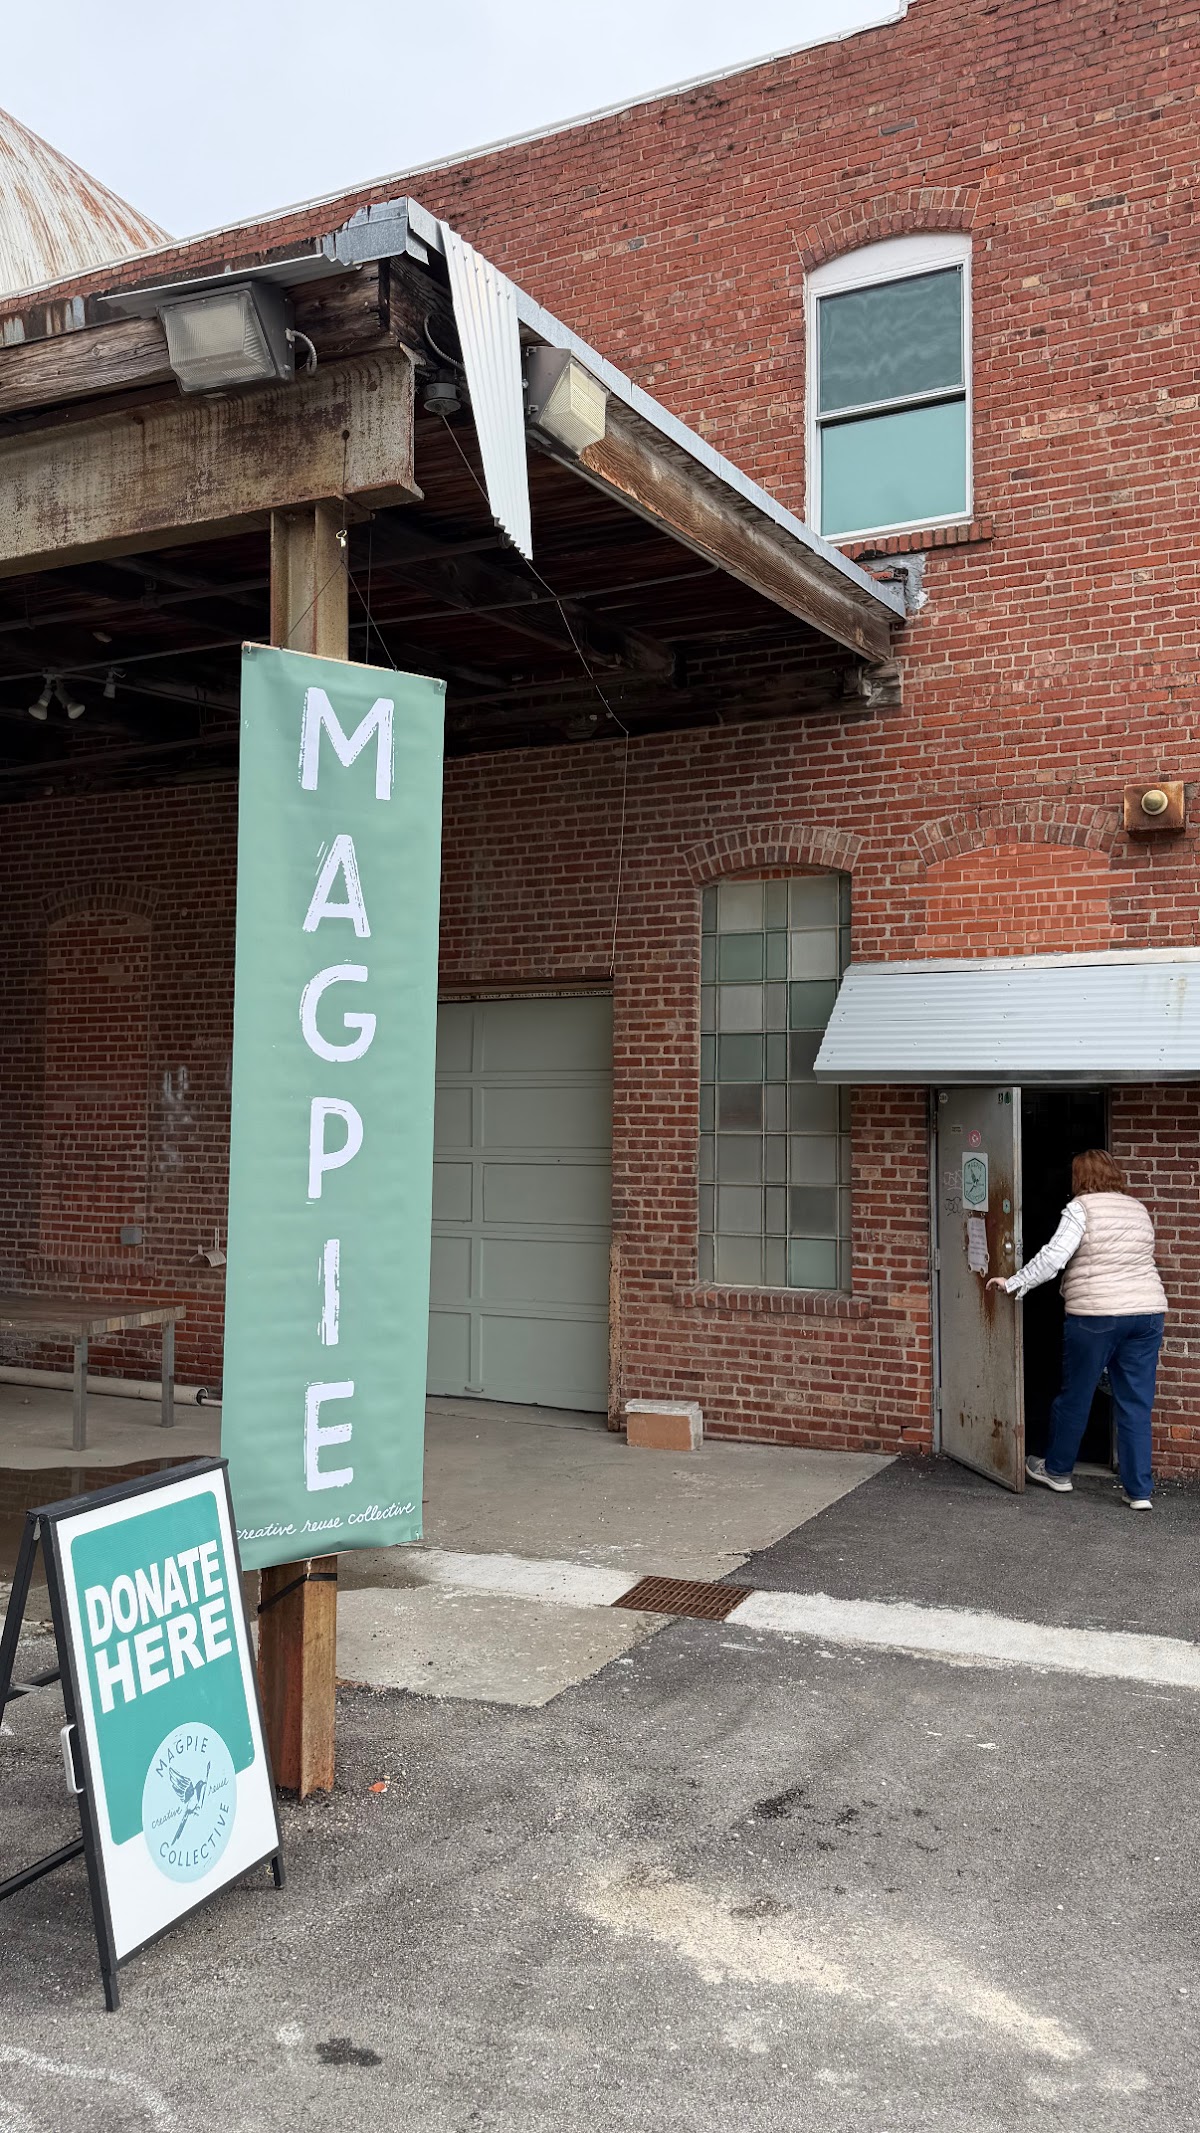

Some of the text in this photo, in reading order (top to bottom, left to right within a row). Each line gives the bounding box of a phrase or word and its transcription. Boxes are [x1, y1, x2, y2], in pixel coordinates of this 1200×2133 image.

[298, 686, 395, 1492] MAGPIE
[300, 1516, 343, 1533] reuse
[348, 1501, 416, 1525] collective
[84, 1539, 224, 1648] DONATE
[94, 1596, 233, 1714] HERE
[155, 1735, 209, 1778] MAGPIE
[151, 1777, 229, 1830] creative reuse
[159, 1802, 230, 1867] COLLECTIVE
